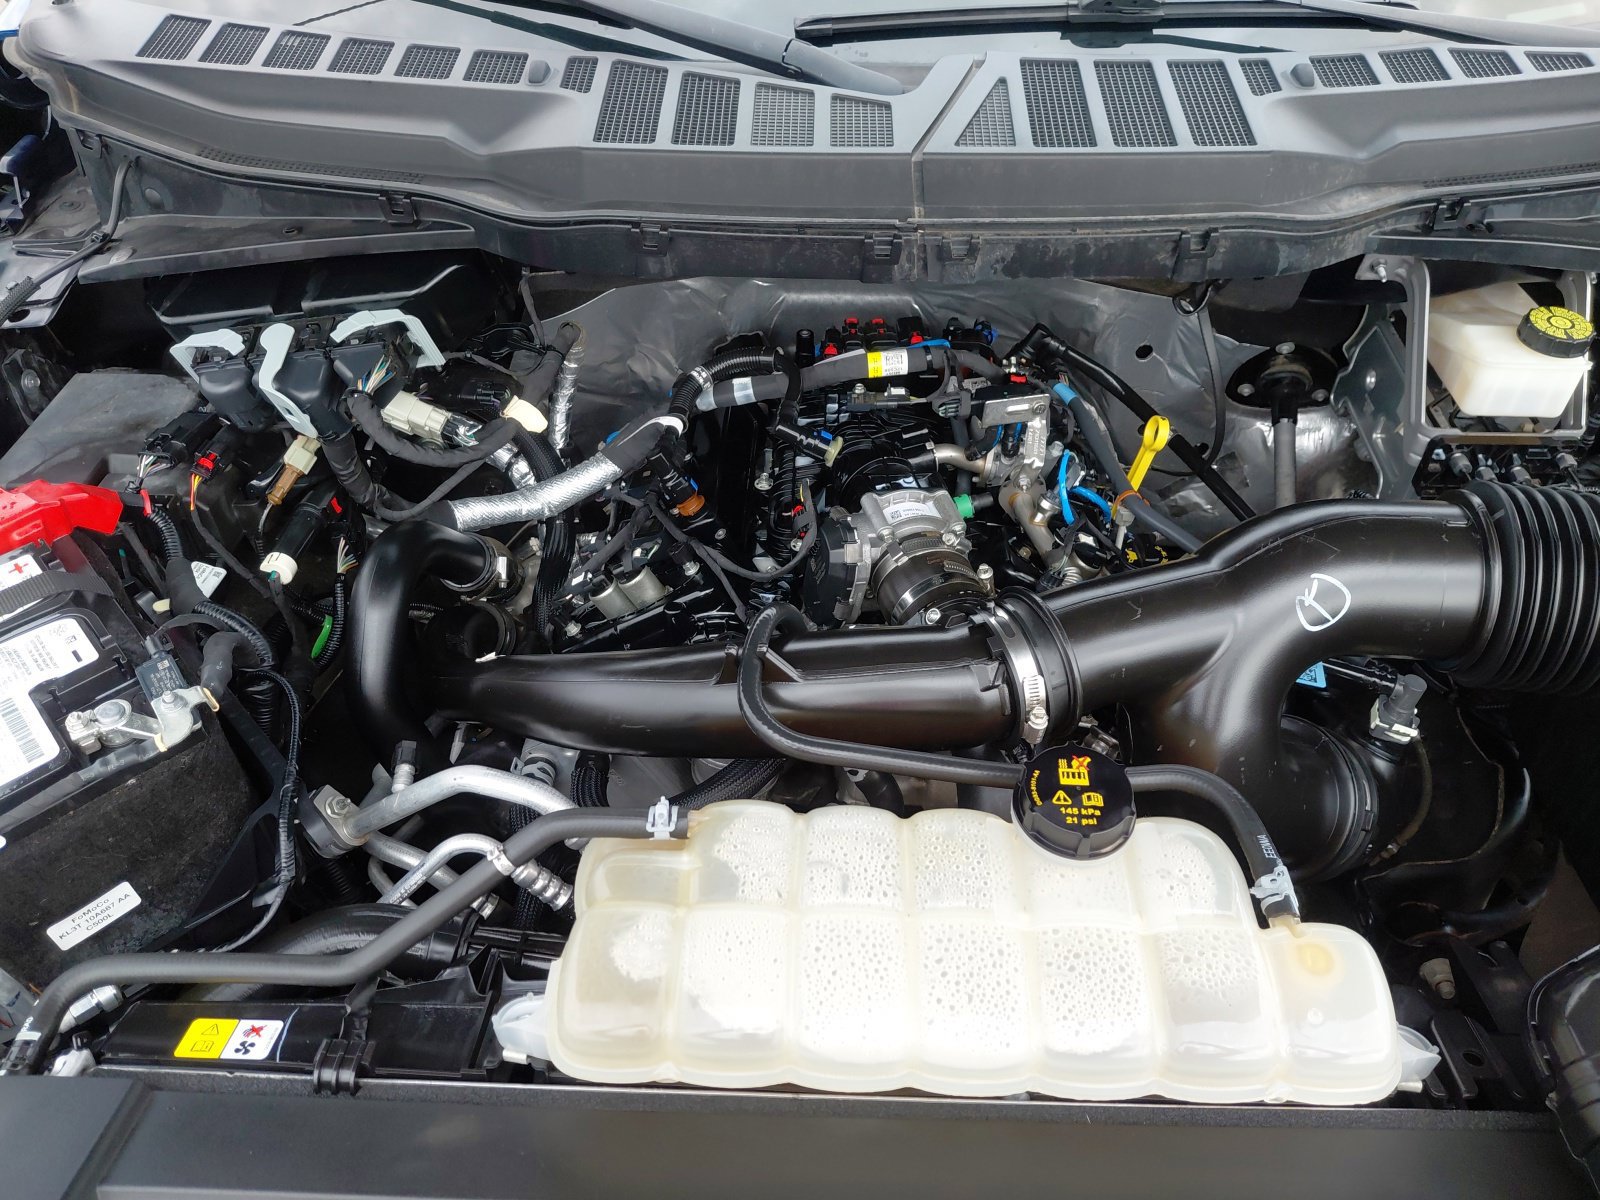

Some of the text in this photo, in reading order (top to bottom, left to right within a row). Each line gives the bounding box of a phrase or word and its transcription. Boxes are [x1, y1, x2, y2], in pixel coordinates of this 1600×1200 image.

[1060, 807, 1101, 816] 145 kPa
[1066, 816, 1097, 826] 21 psi
[58, 923, 82, 940] KL3T
[118, 893, 131, 903] AA
[71, 898, 110, 923] FoMoCo
[86, 914, 114, 931] C500L
